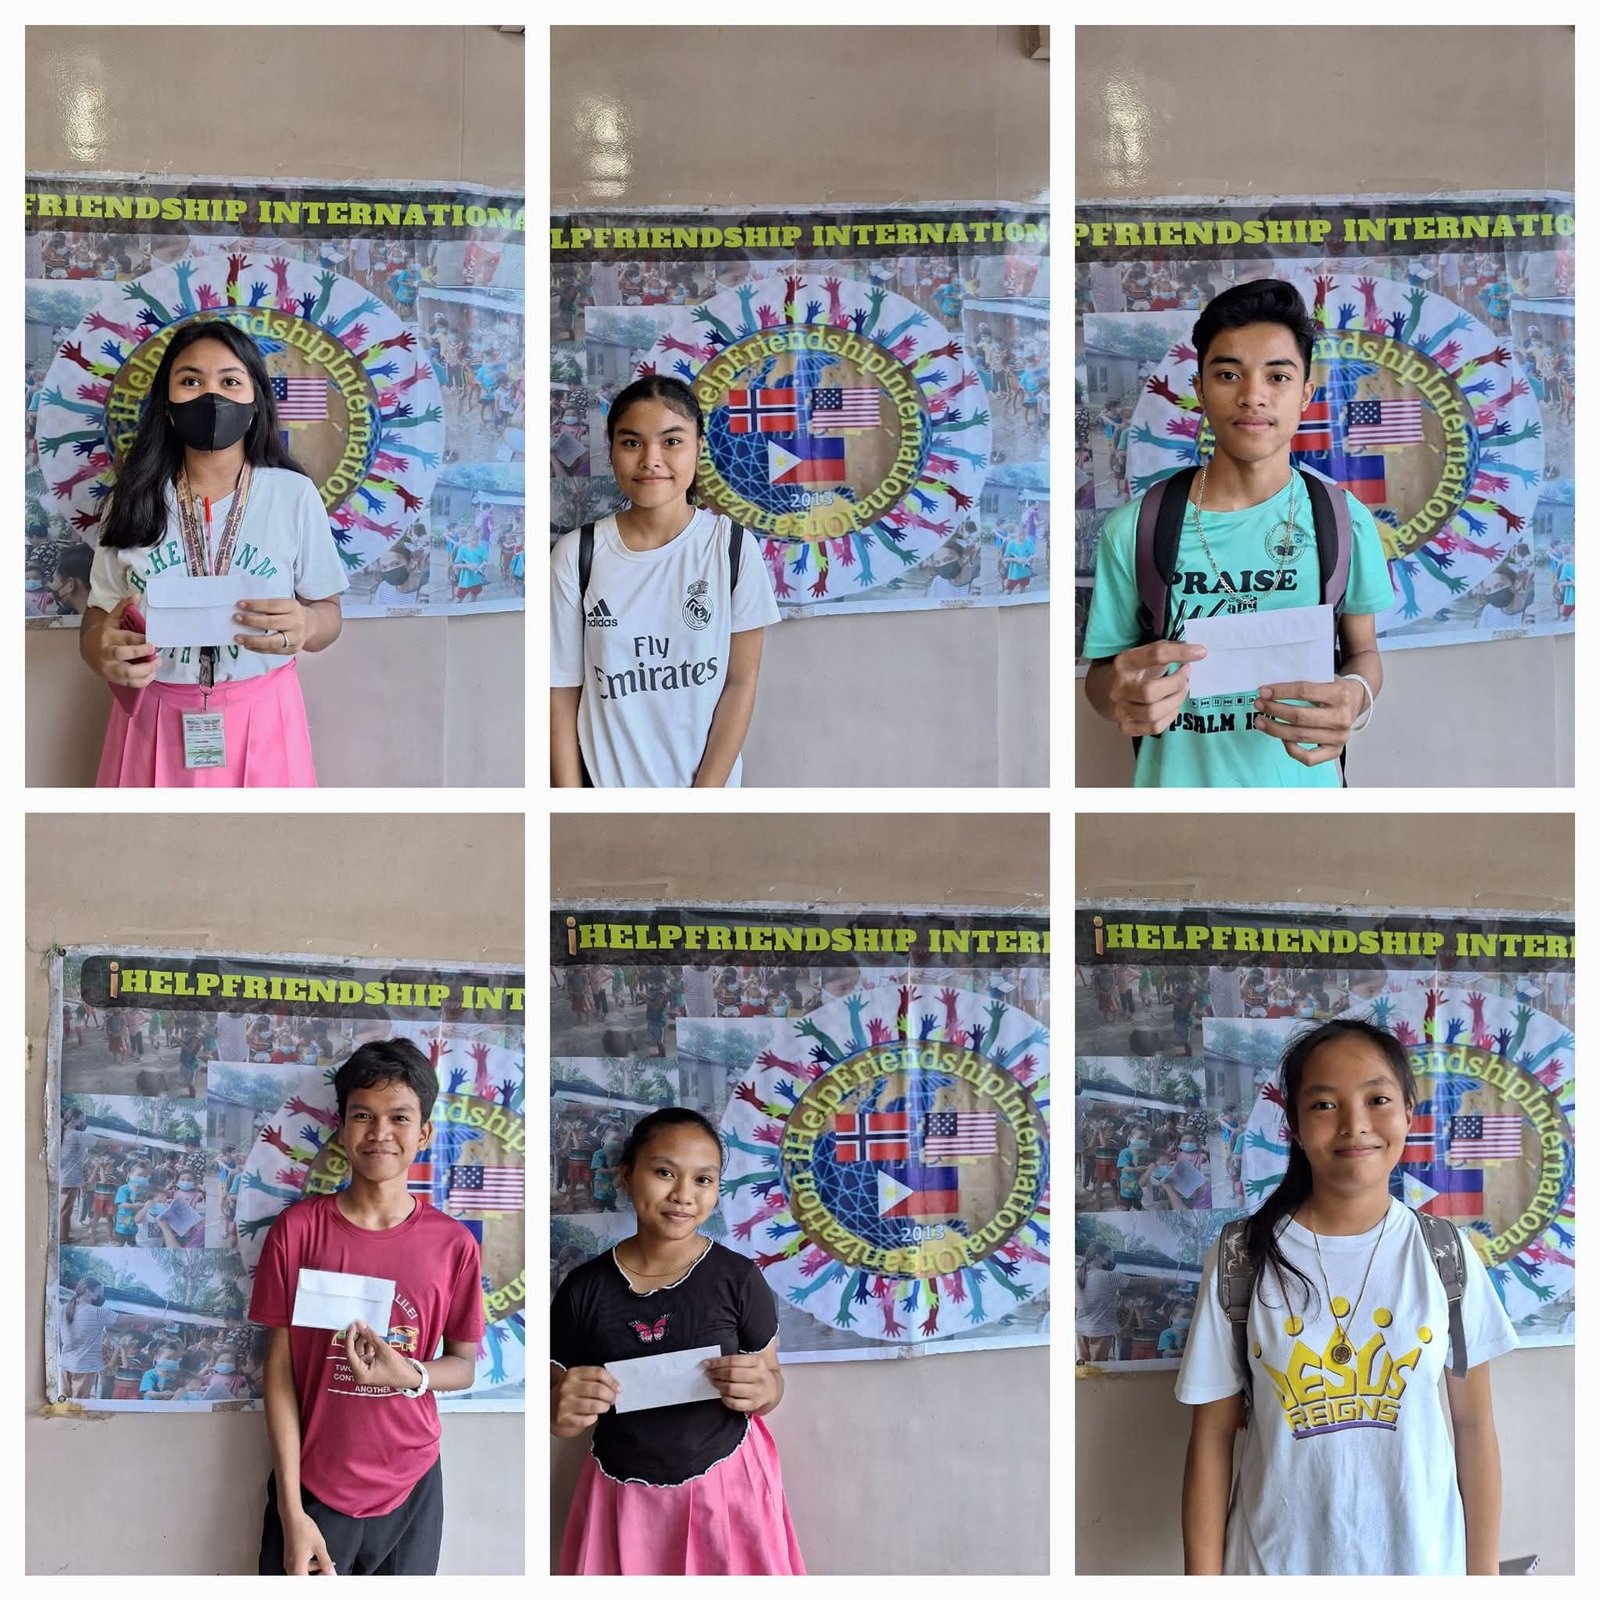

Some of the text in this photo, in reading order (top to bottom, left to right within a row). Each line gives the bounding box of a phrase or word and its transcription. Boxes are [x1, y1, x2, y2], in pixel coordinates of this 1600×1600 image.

[790, 491, 834, 508] 2013
[633, 636, 670, 659] Fly
[928, 929, 1050, 954] INTER
[1455, 933, 1575, 959] INTER
[900, 1225, 946, 1242] 2013
[1262, 1323, 1423, 1412] JESUS
[1284, 1398, 1402, 1432] REIGNS
